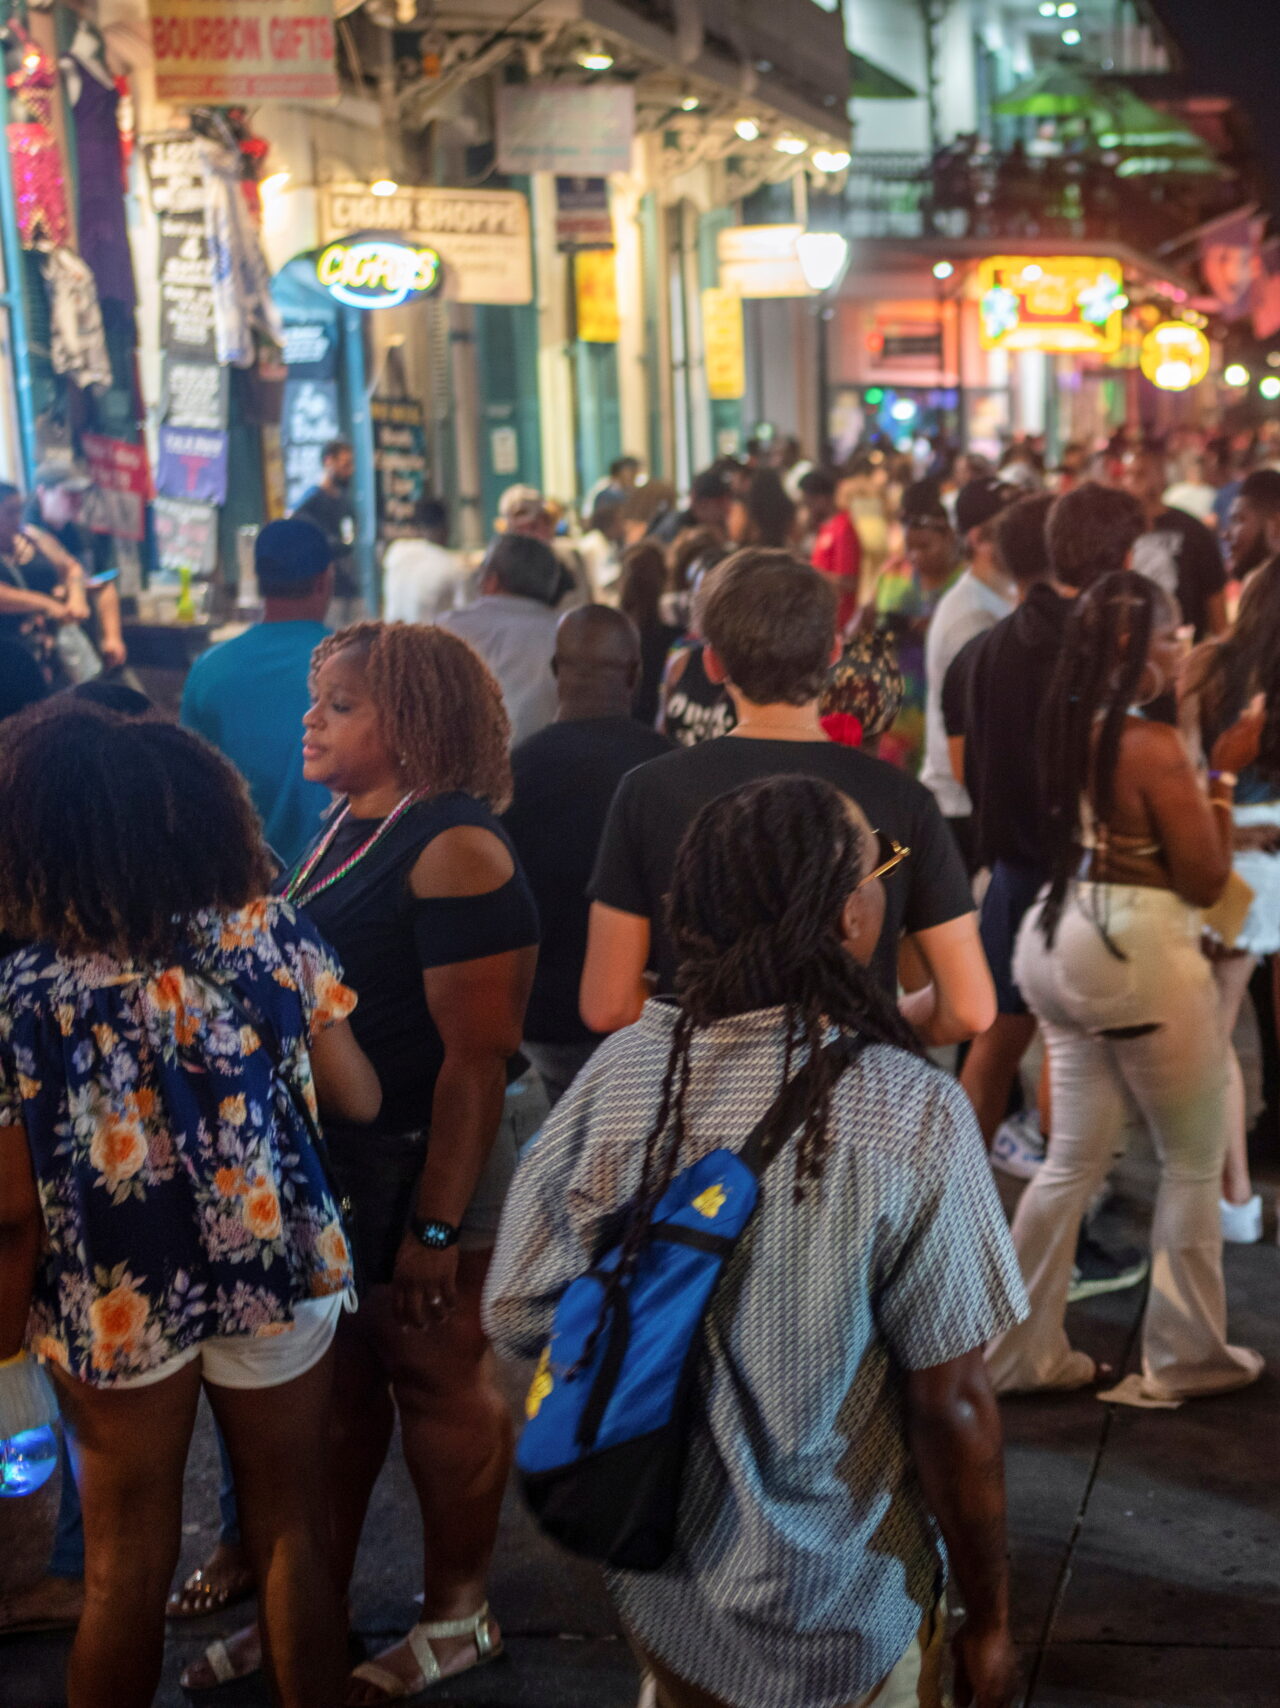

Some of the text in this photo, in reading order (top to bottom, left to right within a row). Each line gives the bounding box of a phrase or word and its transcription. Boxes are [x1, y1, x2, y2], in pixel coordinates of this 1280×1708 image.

[153, 16, 335, 61] BOURBON GIFTS
[333, 195, 414, 231] CIGAR
[417, 200, 521, 234] SHOPPE
[317, 243, 440, 292] CIGAS
